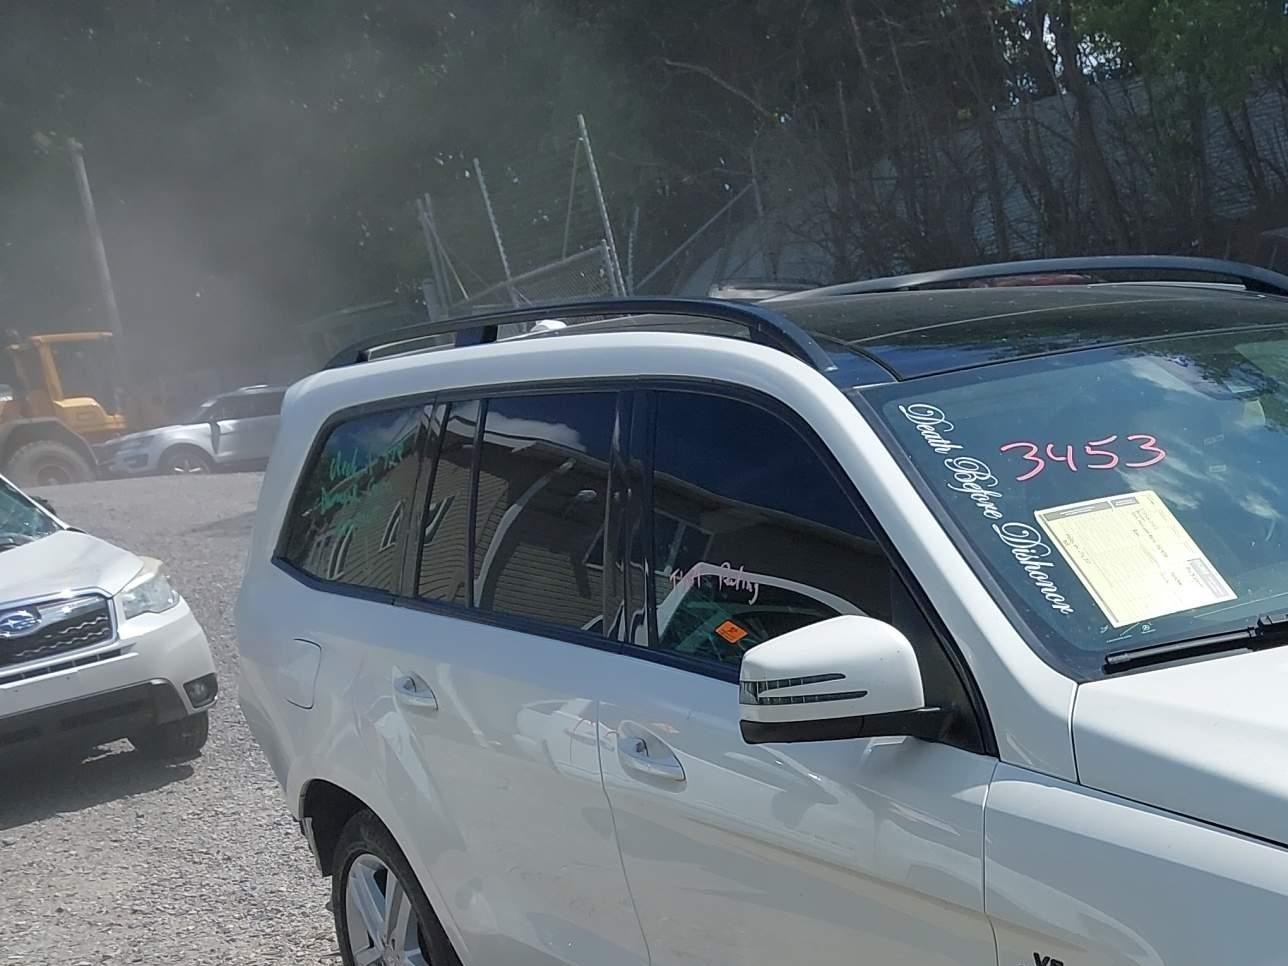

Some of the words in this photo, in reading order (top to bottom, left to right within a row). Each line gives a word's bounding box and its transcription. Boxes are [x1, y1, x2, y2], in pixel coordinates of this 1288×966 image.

[898, 402, 965, 455] Death
[944, 455, 1004, 520] Before
[992, 520, 1076, 616] Dishonor
[999, 433, 1168, 482] 3453
